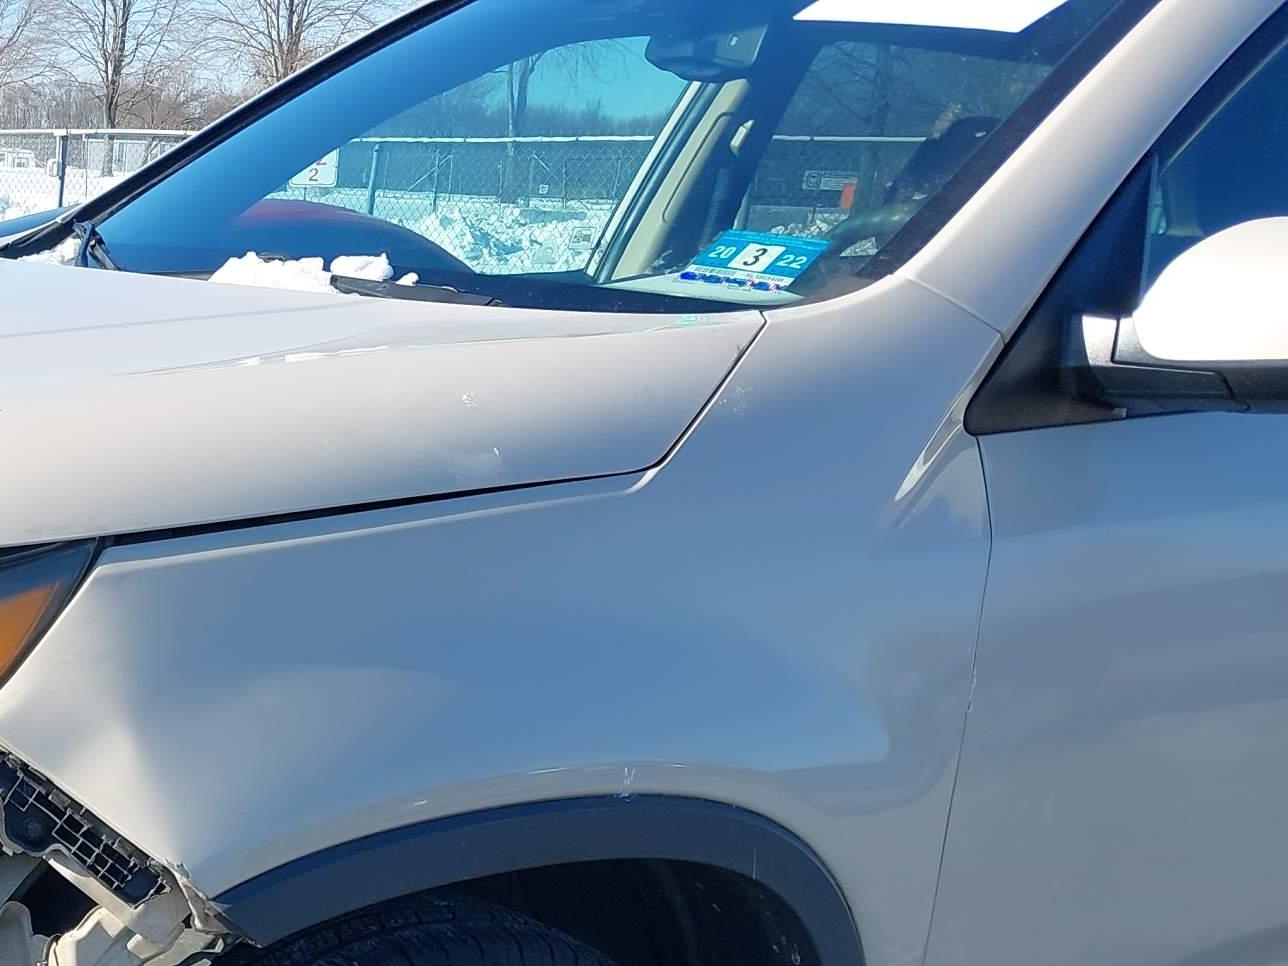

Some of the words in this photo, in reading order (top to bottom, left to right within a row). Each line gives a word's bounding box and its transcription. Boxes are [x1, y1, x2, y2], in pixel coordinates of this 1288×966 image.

[708, 245, 737, 259] 20
[744, 248, 768, 267] 3
[776, 254, 808, 269] 22
